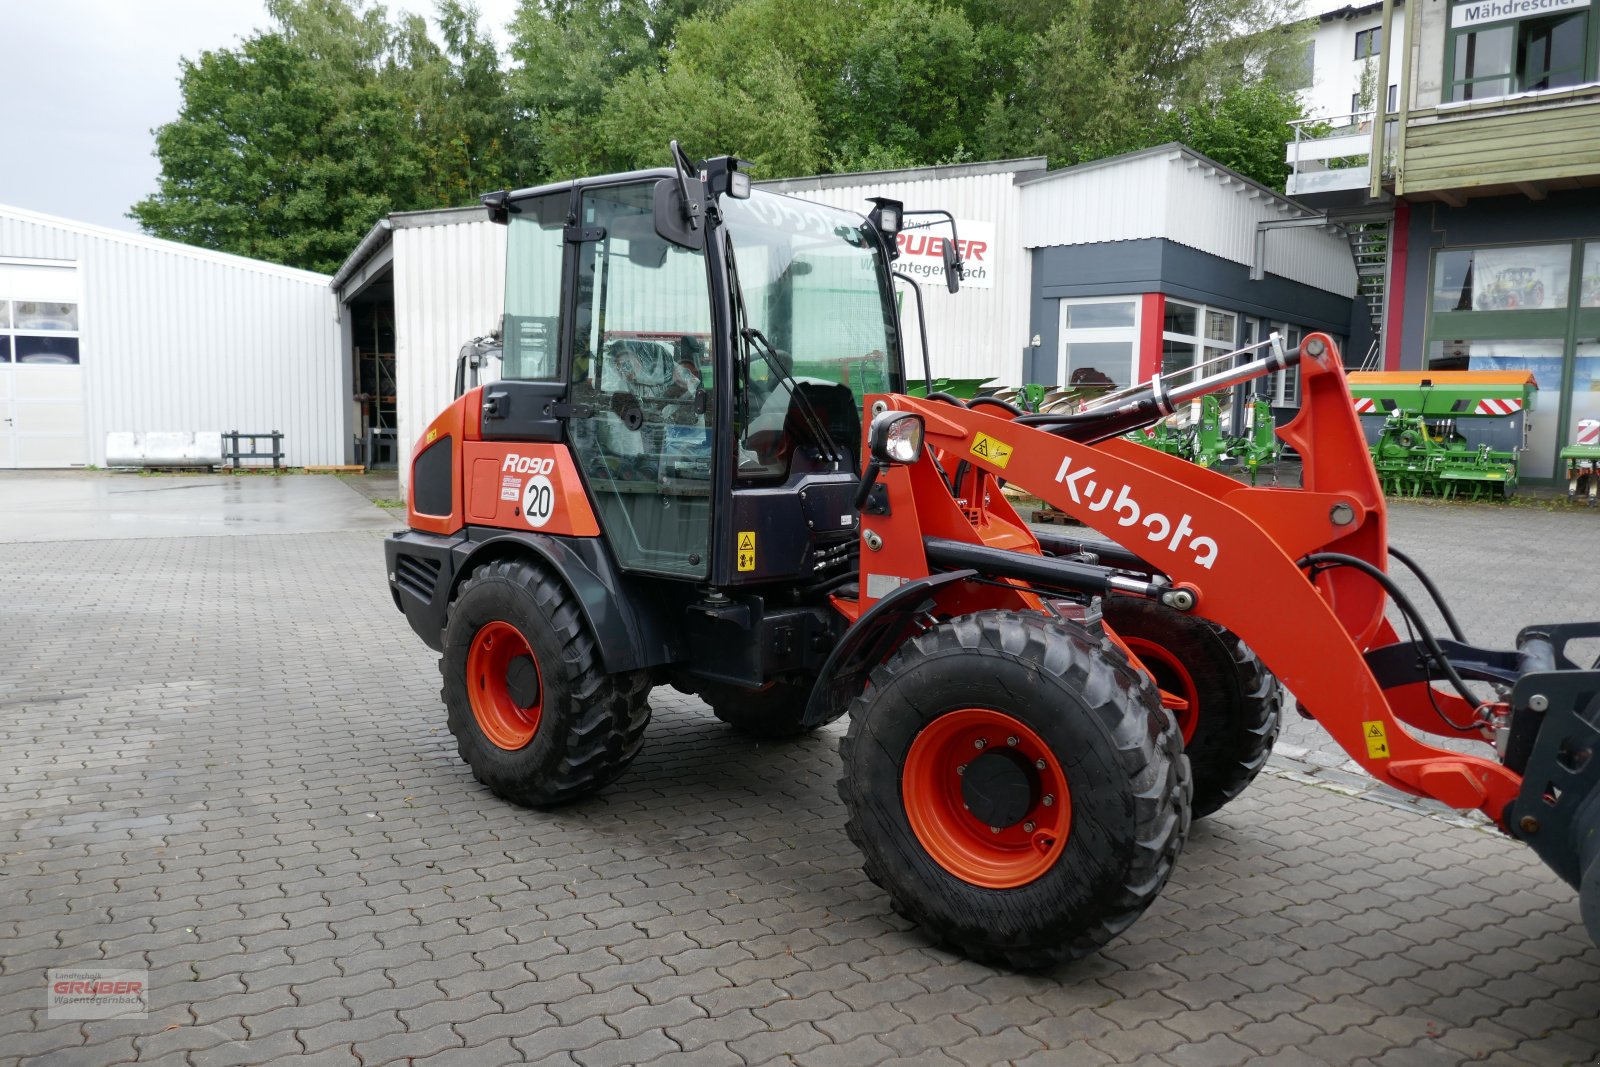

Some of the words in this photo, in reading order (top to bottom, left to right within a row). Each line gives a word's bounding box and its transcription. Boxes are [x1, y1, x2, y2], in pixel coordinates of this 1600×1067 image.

[896, 233, 988, 261] RUBER
[502, 454, 554, 475] R090
[527, 485, 550, 517] 20
[1054, 456, 1219, 570] Kubota
